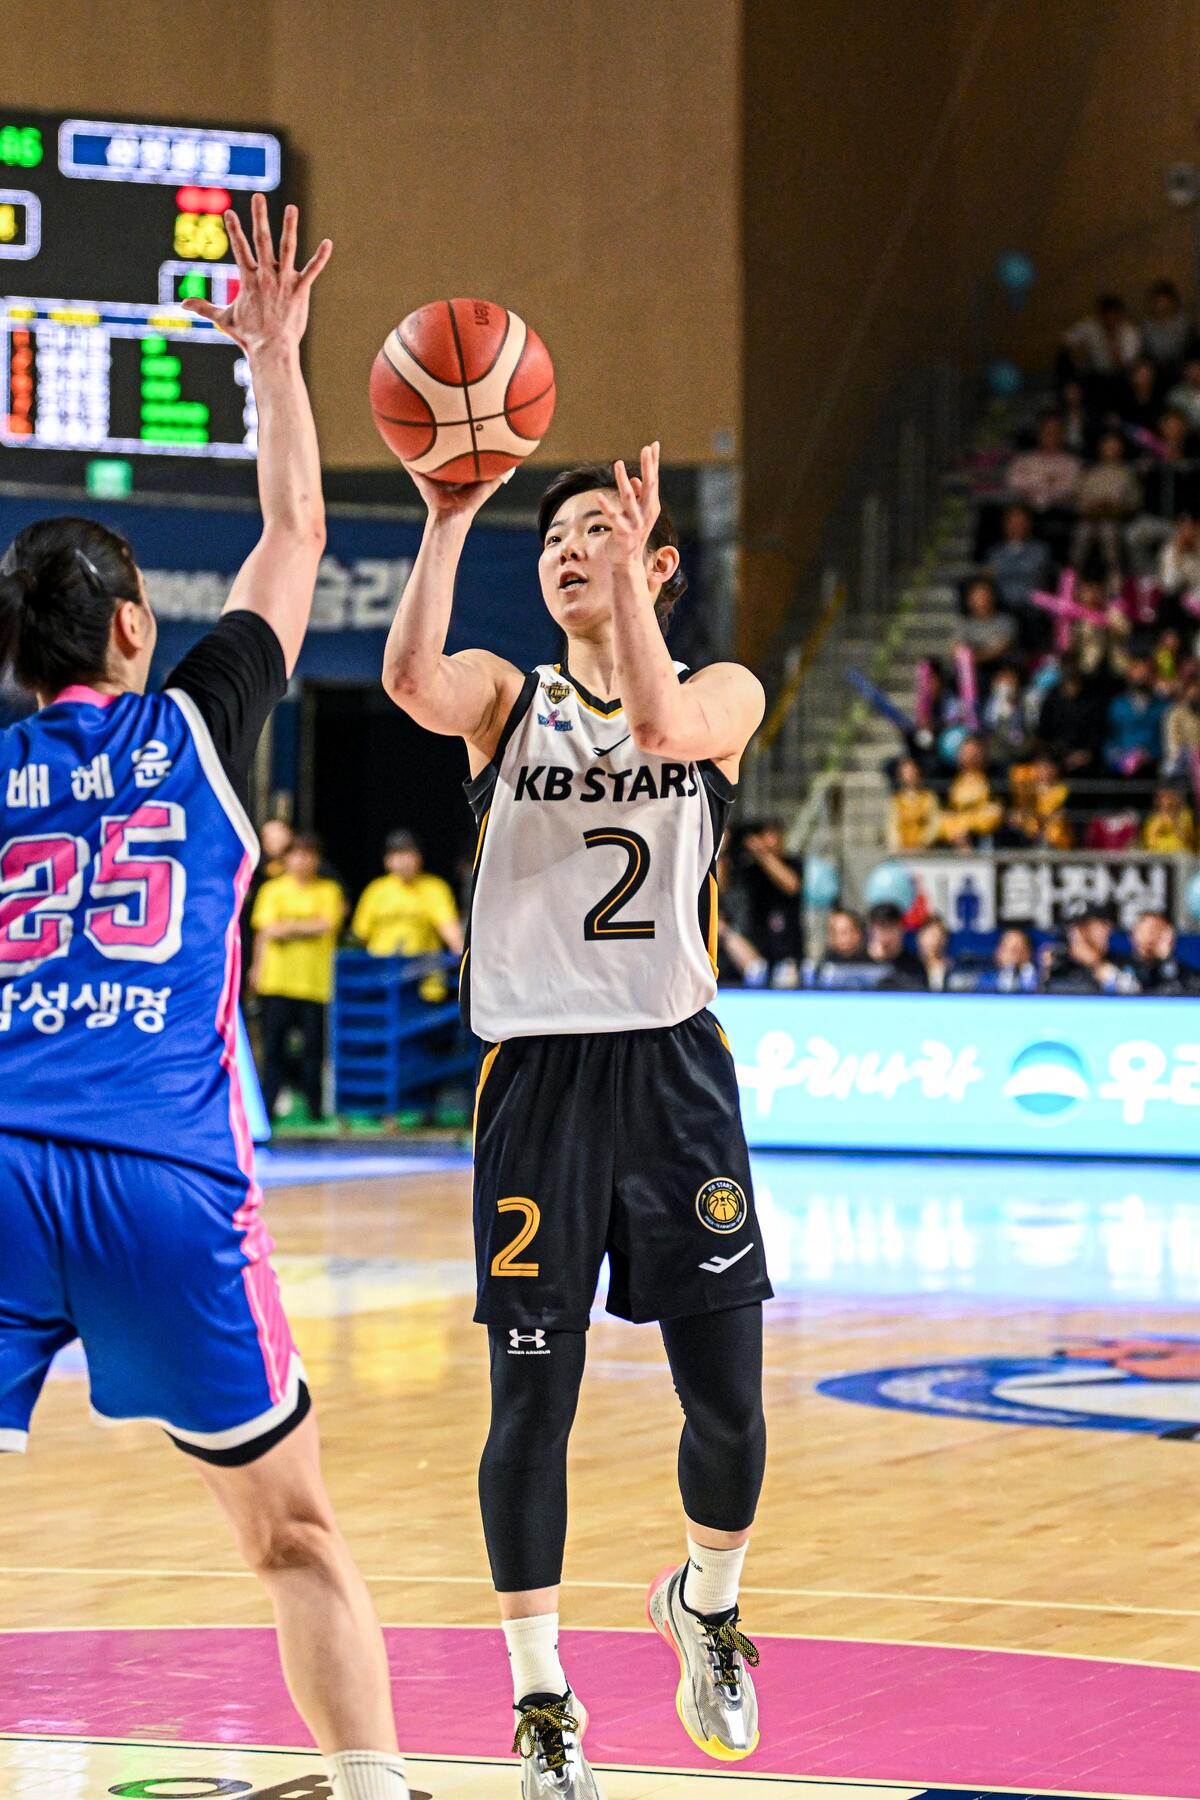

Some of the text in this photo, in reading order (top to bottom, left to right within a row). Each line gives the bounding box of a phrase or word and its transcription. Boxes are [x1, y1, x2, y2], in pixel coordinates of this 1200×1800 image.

[513, 762, 698, 803] KB STARS
[0, 800, 187, 978] 25
[582, 826, 656, 941] 2
[490, 1196, 541, 1277] 2
